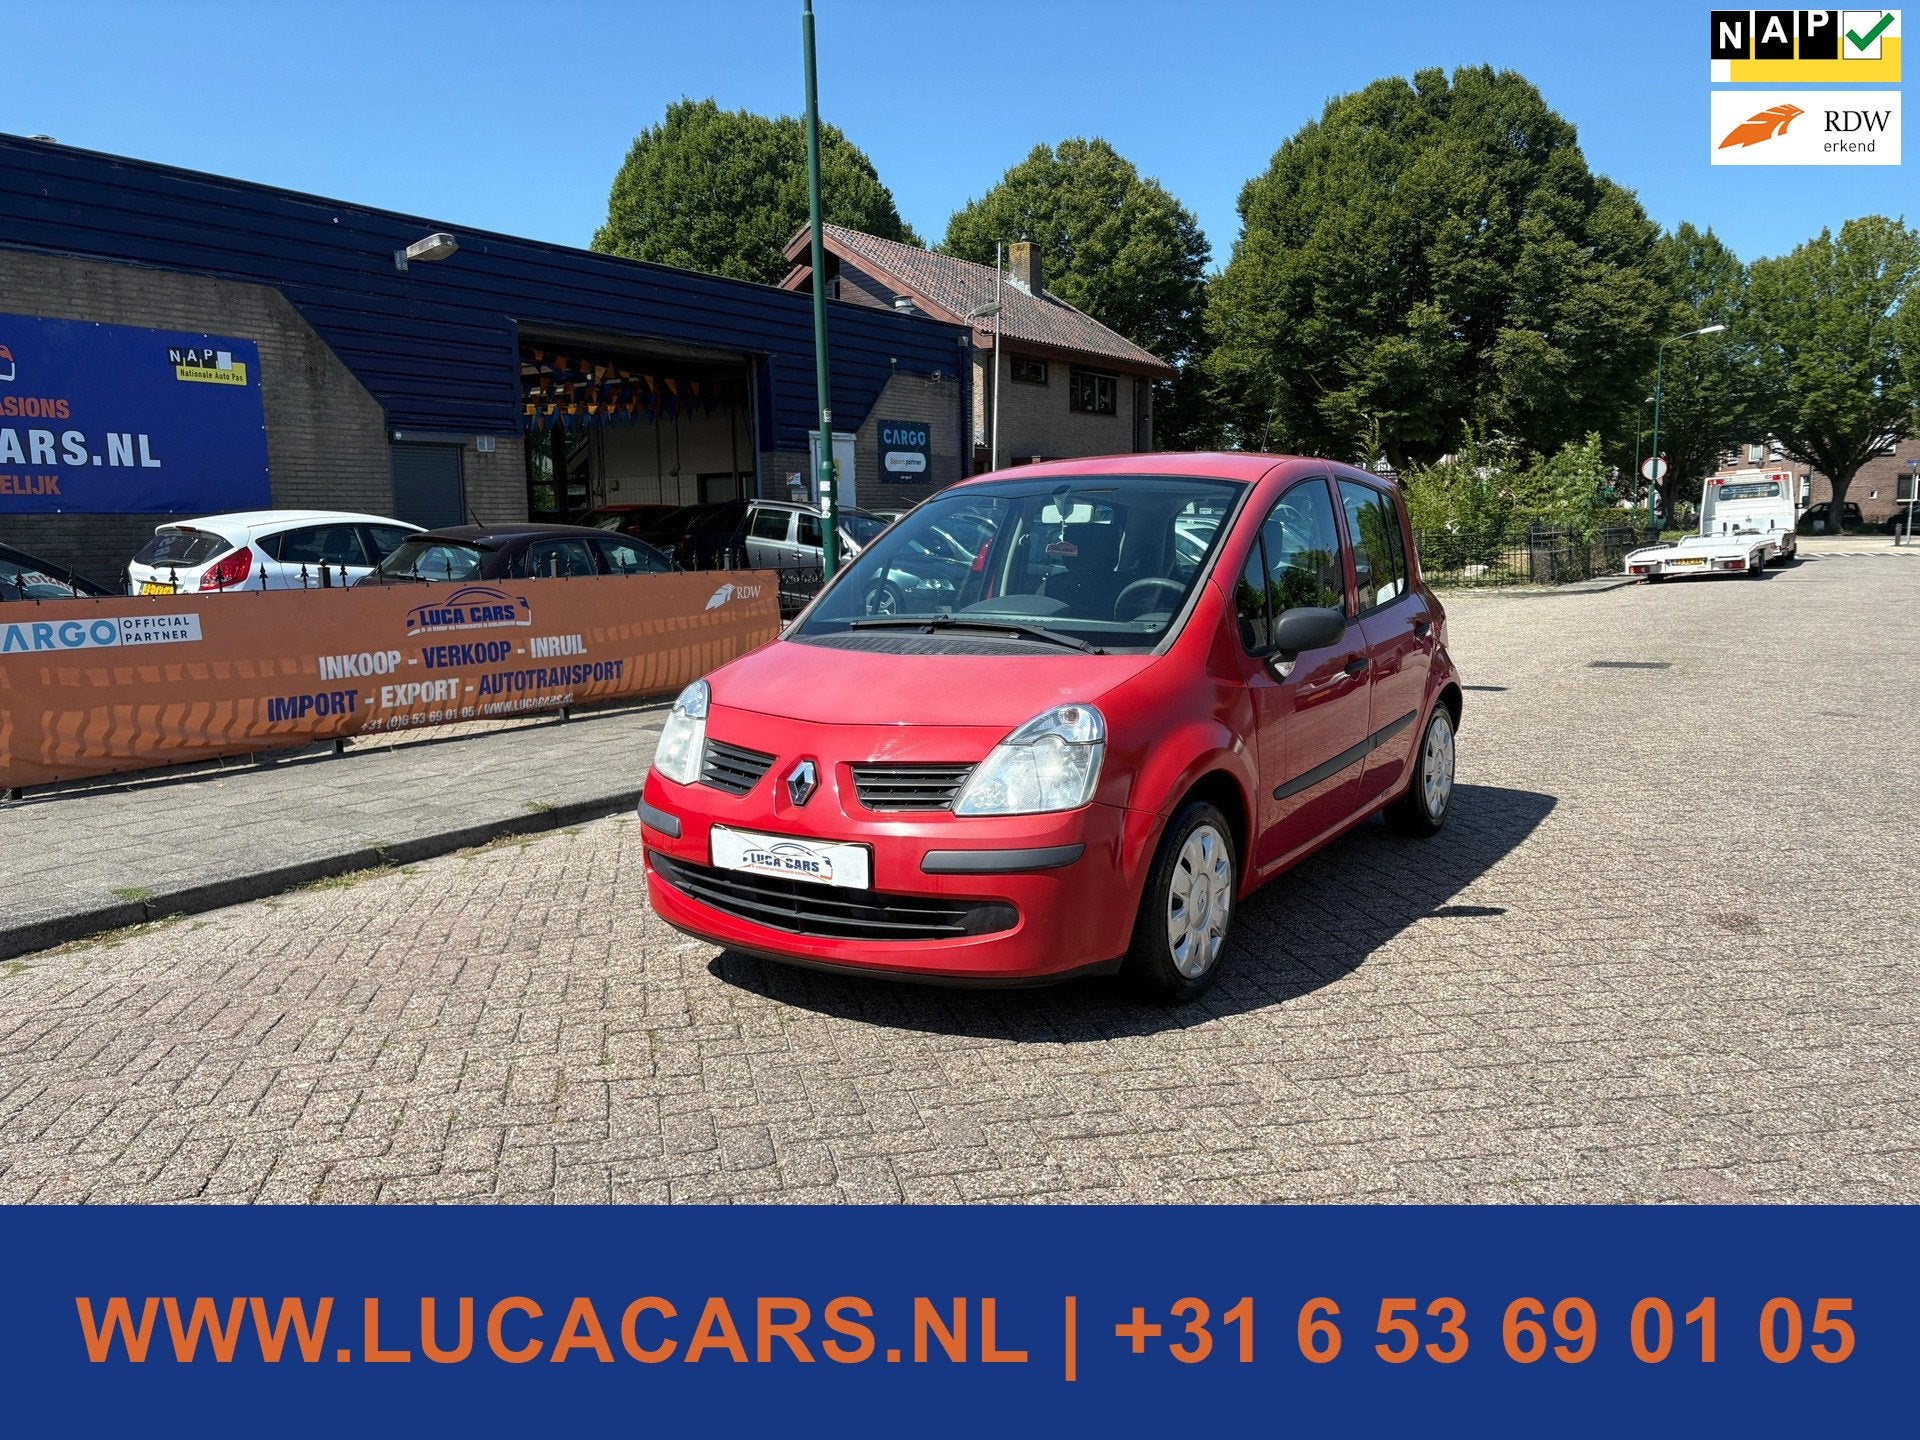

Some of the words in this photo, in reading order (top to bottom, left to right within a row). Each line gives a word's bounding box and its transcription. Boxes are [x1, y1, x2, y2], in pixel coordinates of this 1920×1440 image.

[169, 349, 213, 362] NAP
[180, 369, 213, 379] Nationale
[215, 372, 230, 380] Auto
[231, 374, 244, 382] Pas
[883, 429, 926, 446] CARGO
[0, 428, 162, 468] ARS.NL
[736, 585, 762, 600] RDW
[123, 616, 190, 629] OFFICIAL
[420, 606, 465, 626] LUCA
[470, 605, 516, 623] CARS
[3, 619, 117, 652] ARGO
[125, 630, 188, 643] PARTNER
[318, 650, 402, 681] INKOOP
[422, 640, 512, 669] VERKOOP
[530, 634, 588, 659] INRUIL
[267, 689, 358, 722] IMPORT
[381, 677, 460, 708] EXPORT
[478, 660, 623, 696] AUTOTRANSPORT
[411, 712, 426, 725] 53
[428, 710, 443, 723] 69
[445, 708, 458, 721] 01
[461, 706, 475, 719] 05
[751, 853, 781, 867] LUCA
[785, 858, 820, 873] CARS
